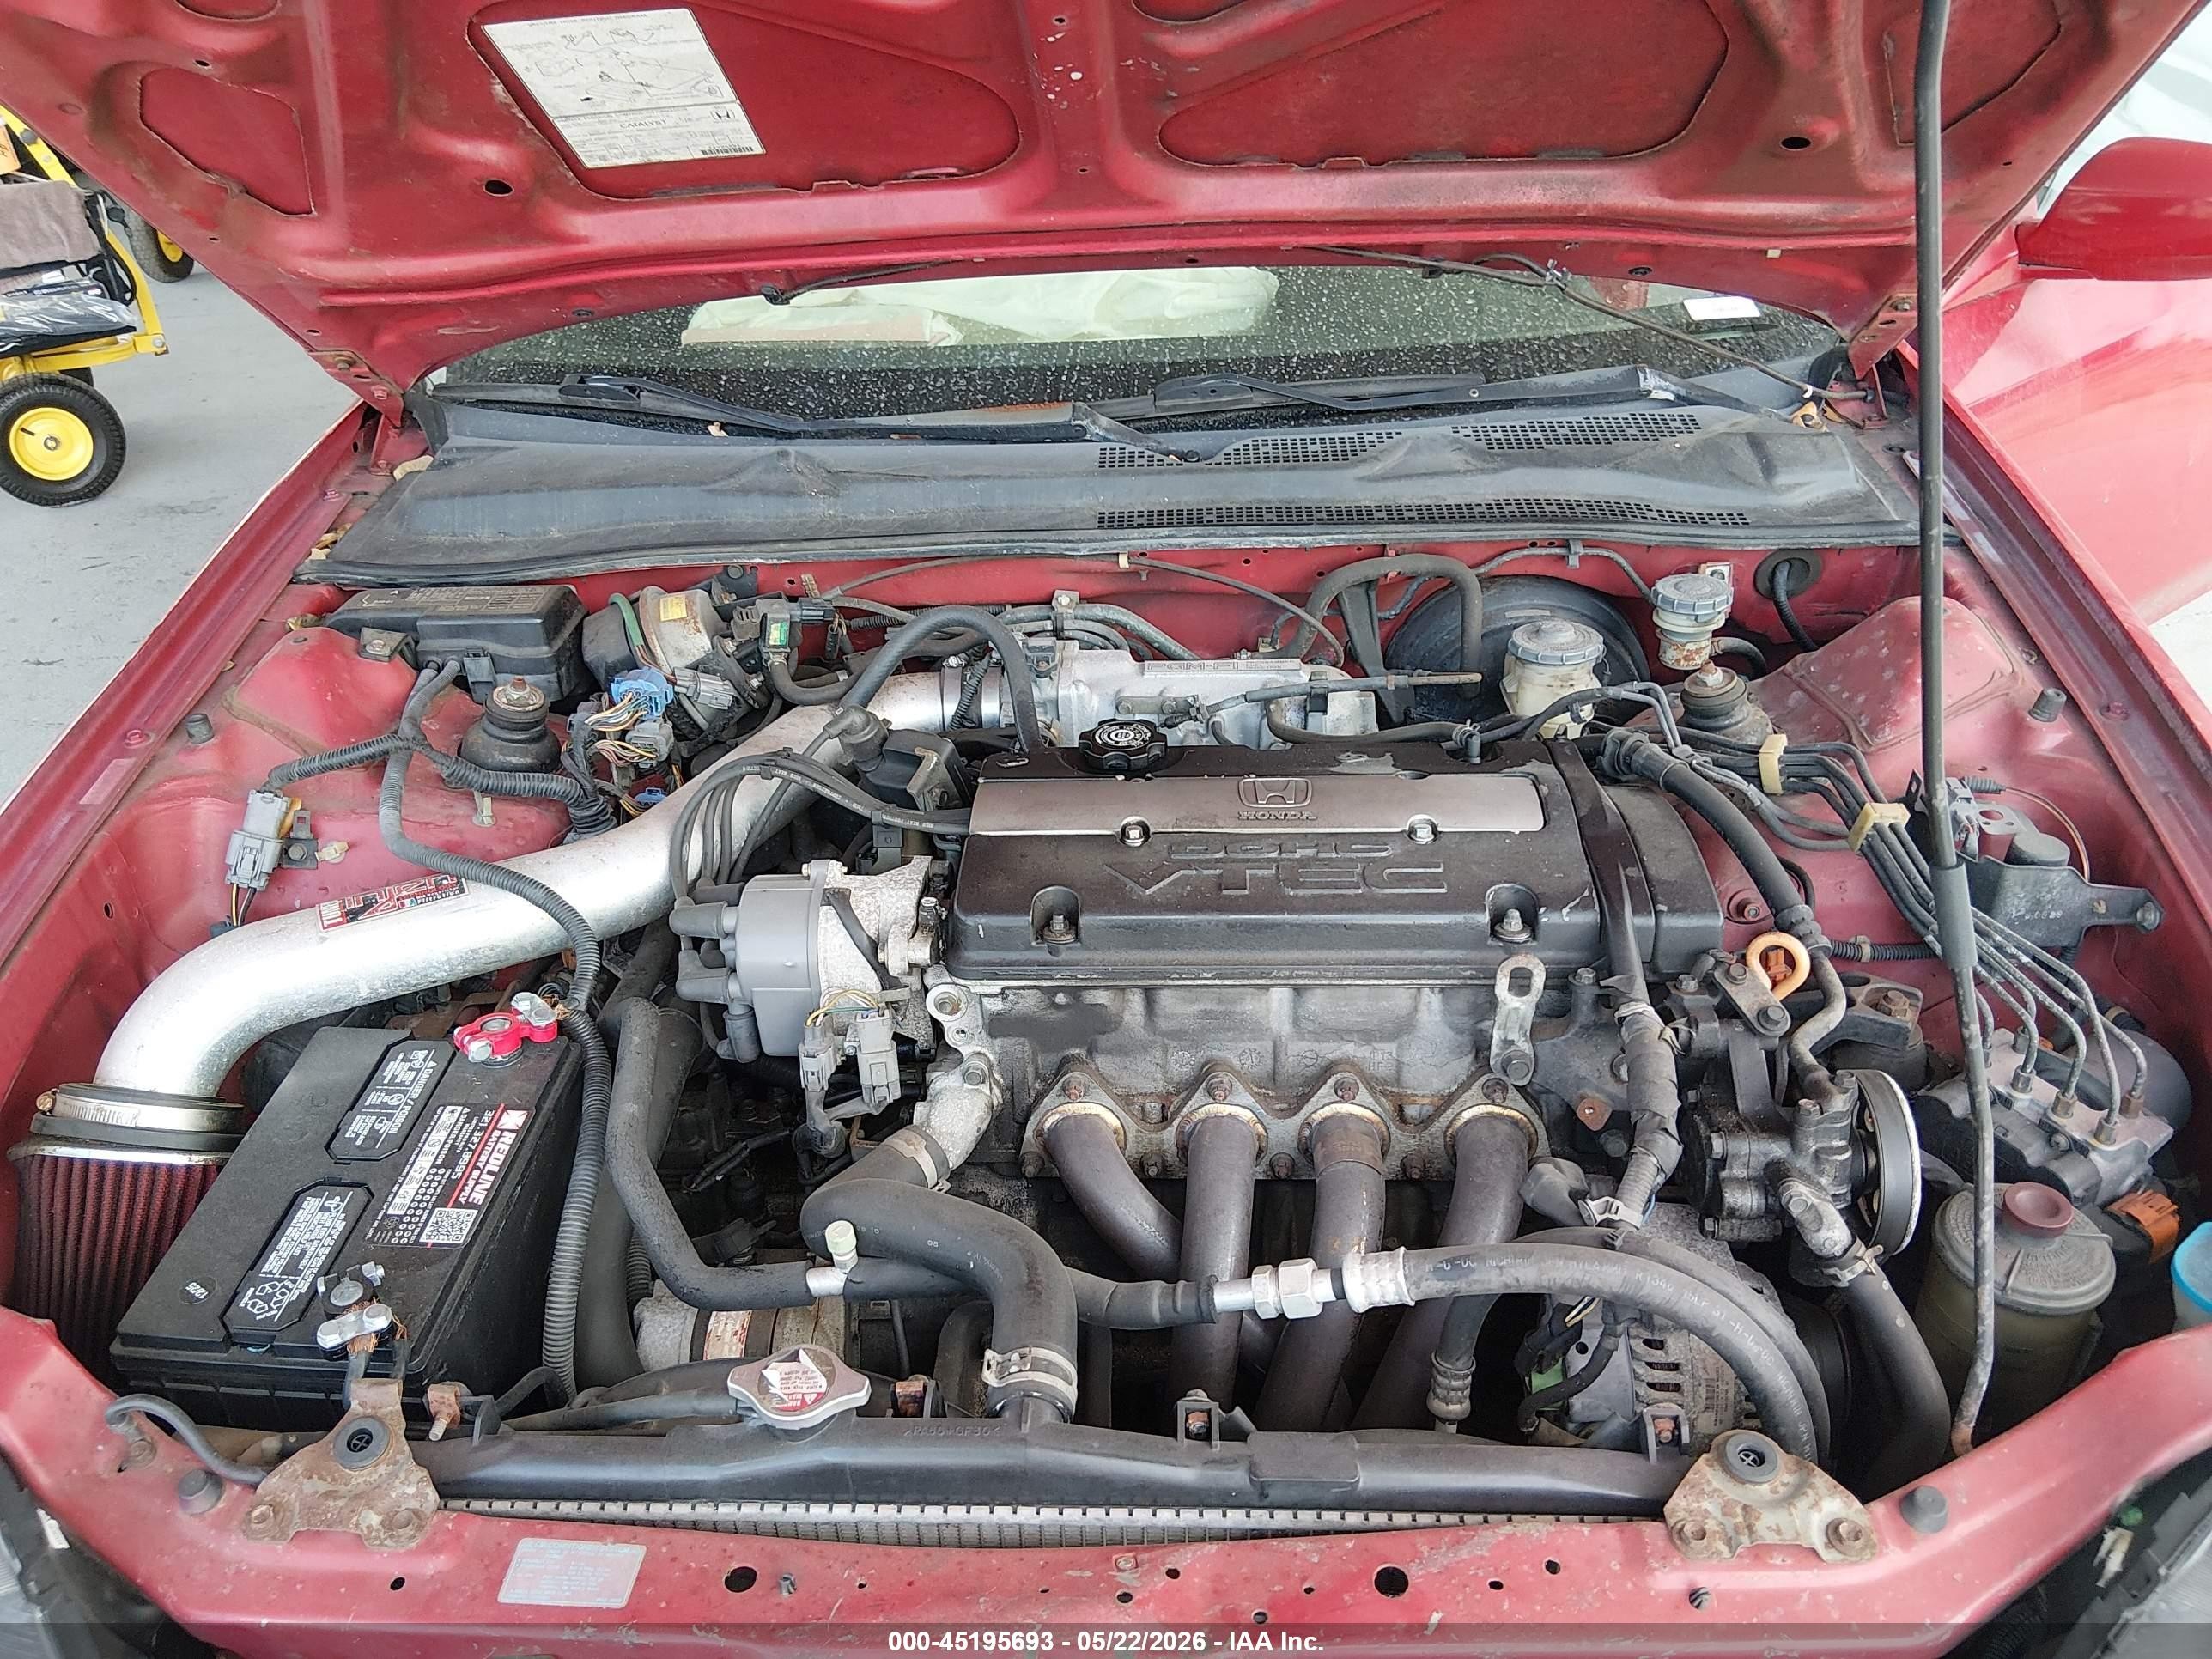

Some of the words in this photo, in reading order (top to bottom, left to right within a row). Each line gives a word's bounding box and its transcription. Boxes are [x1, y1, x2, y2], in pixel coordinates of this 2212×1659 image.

[1238, 811, 1318, 821] HONDA
[1103, 862, 1448, 895] VTEC
[410, 1069, 433, 1098] DANGER
[388, 1104, 411, 1133] POISON
[451, 1110, 495, 1179] 321.327.8995
[477, 1130, 501, 1169] BATTERY
[469, 1132, 516, 1205] REDLINE
[459, 1170, 480, 1204] SUPPLY
